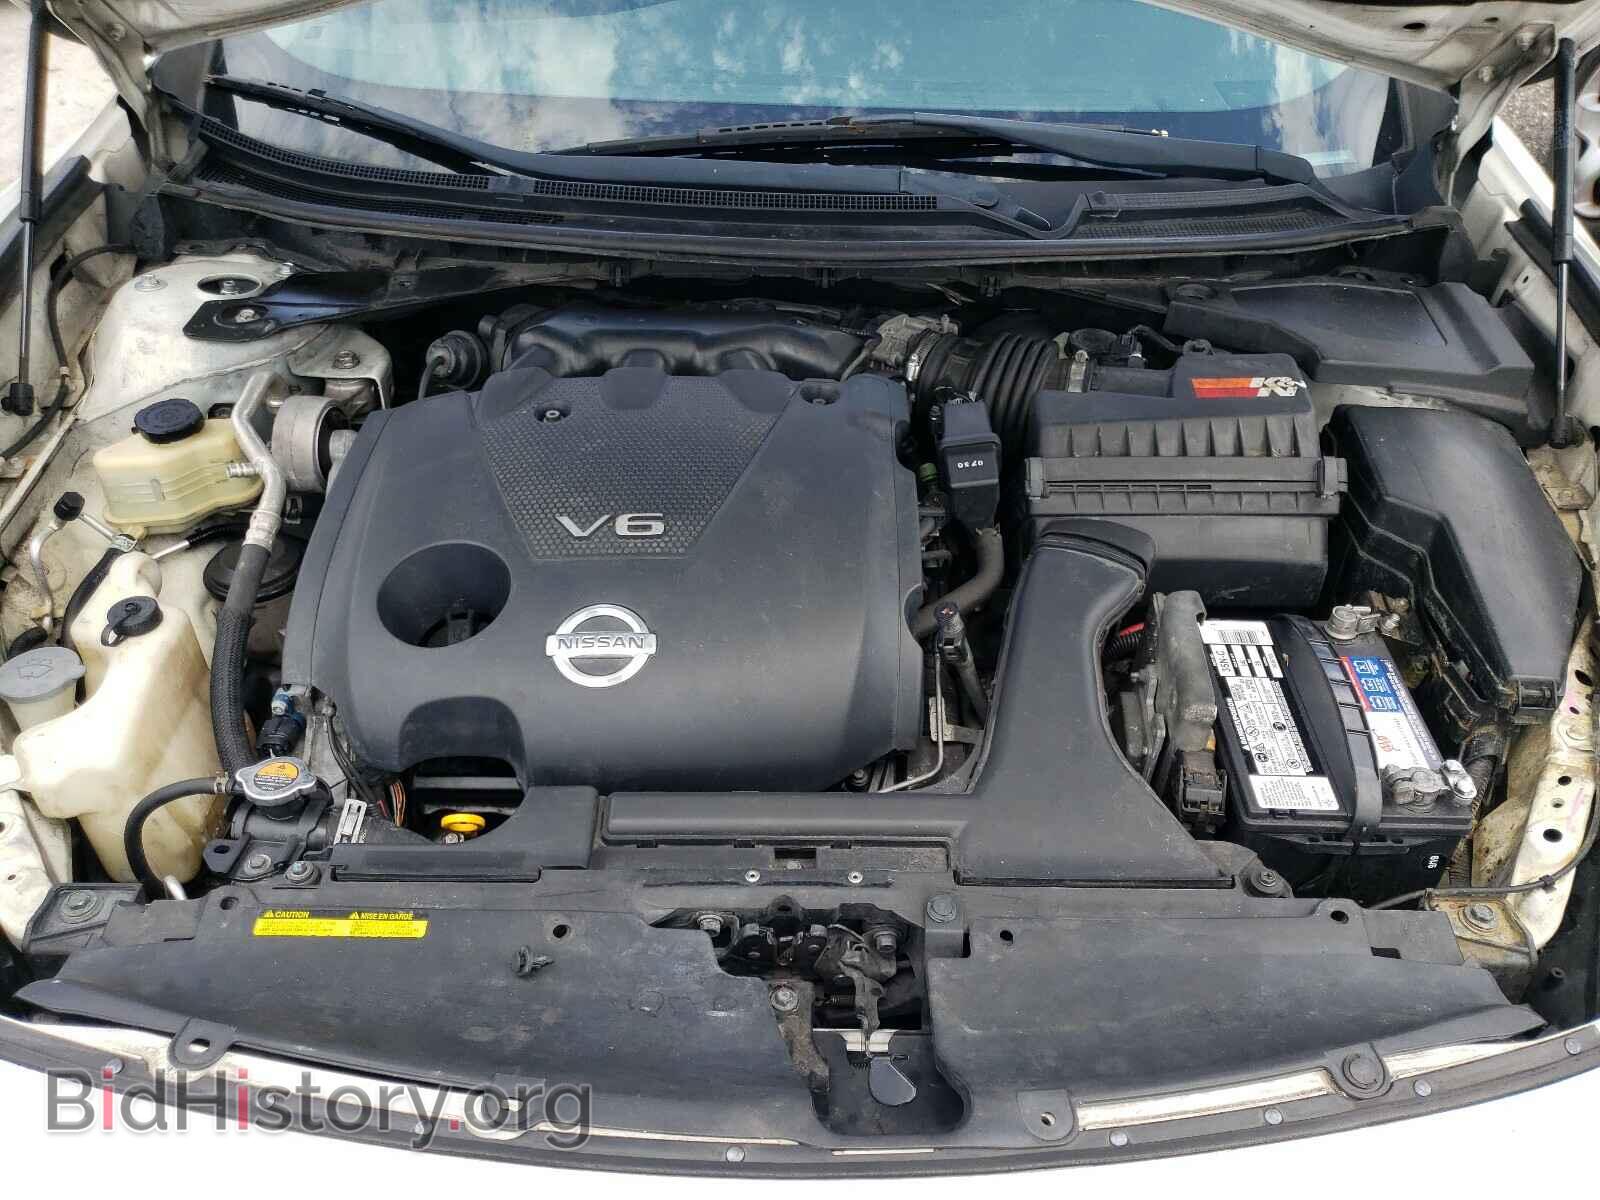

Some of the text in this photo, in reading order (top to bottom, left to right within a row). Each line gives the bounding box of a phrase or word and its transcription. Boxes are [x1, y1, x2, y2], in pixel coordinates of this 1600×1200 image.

[555, 512, 665, 537] V6
[557, 636, 645, 650] NISSAN
[274, 911, 310, 919] CAUTION
[360, 912, 378, 920] MISE
[378, 912, 389, 920] EN
